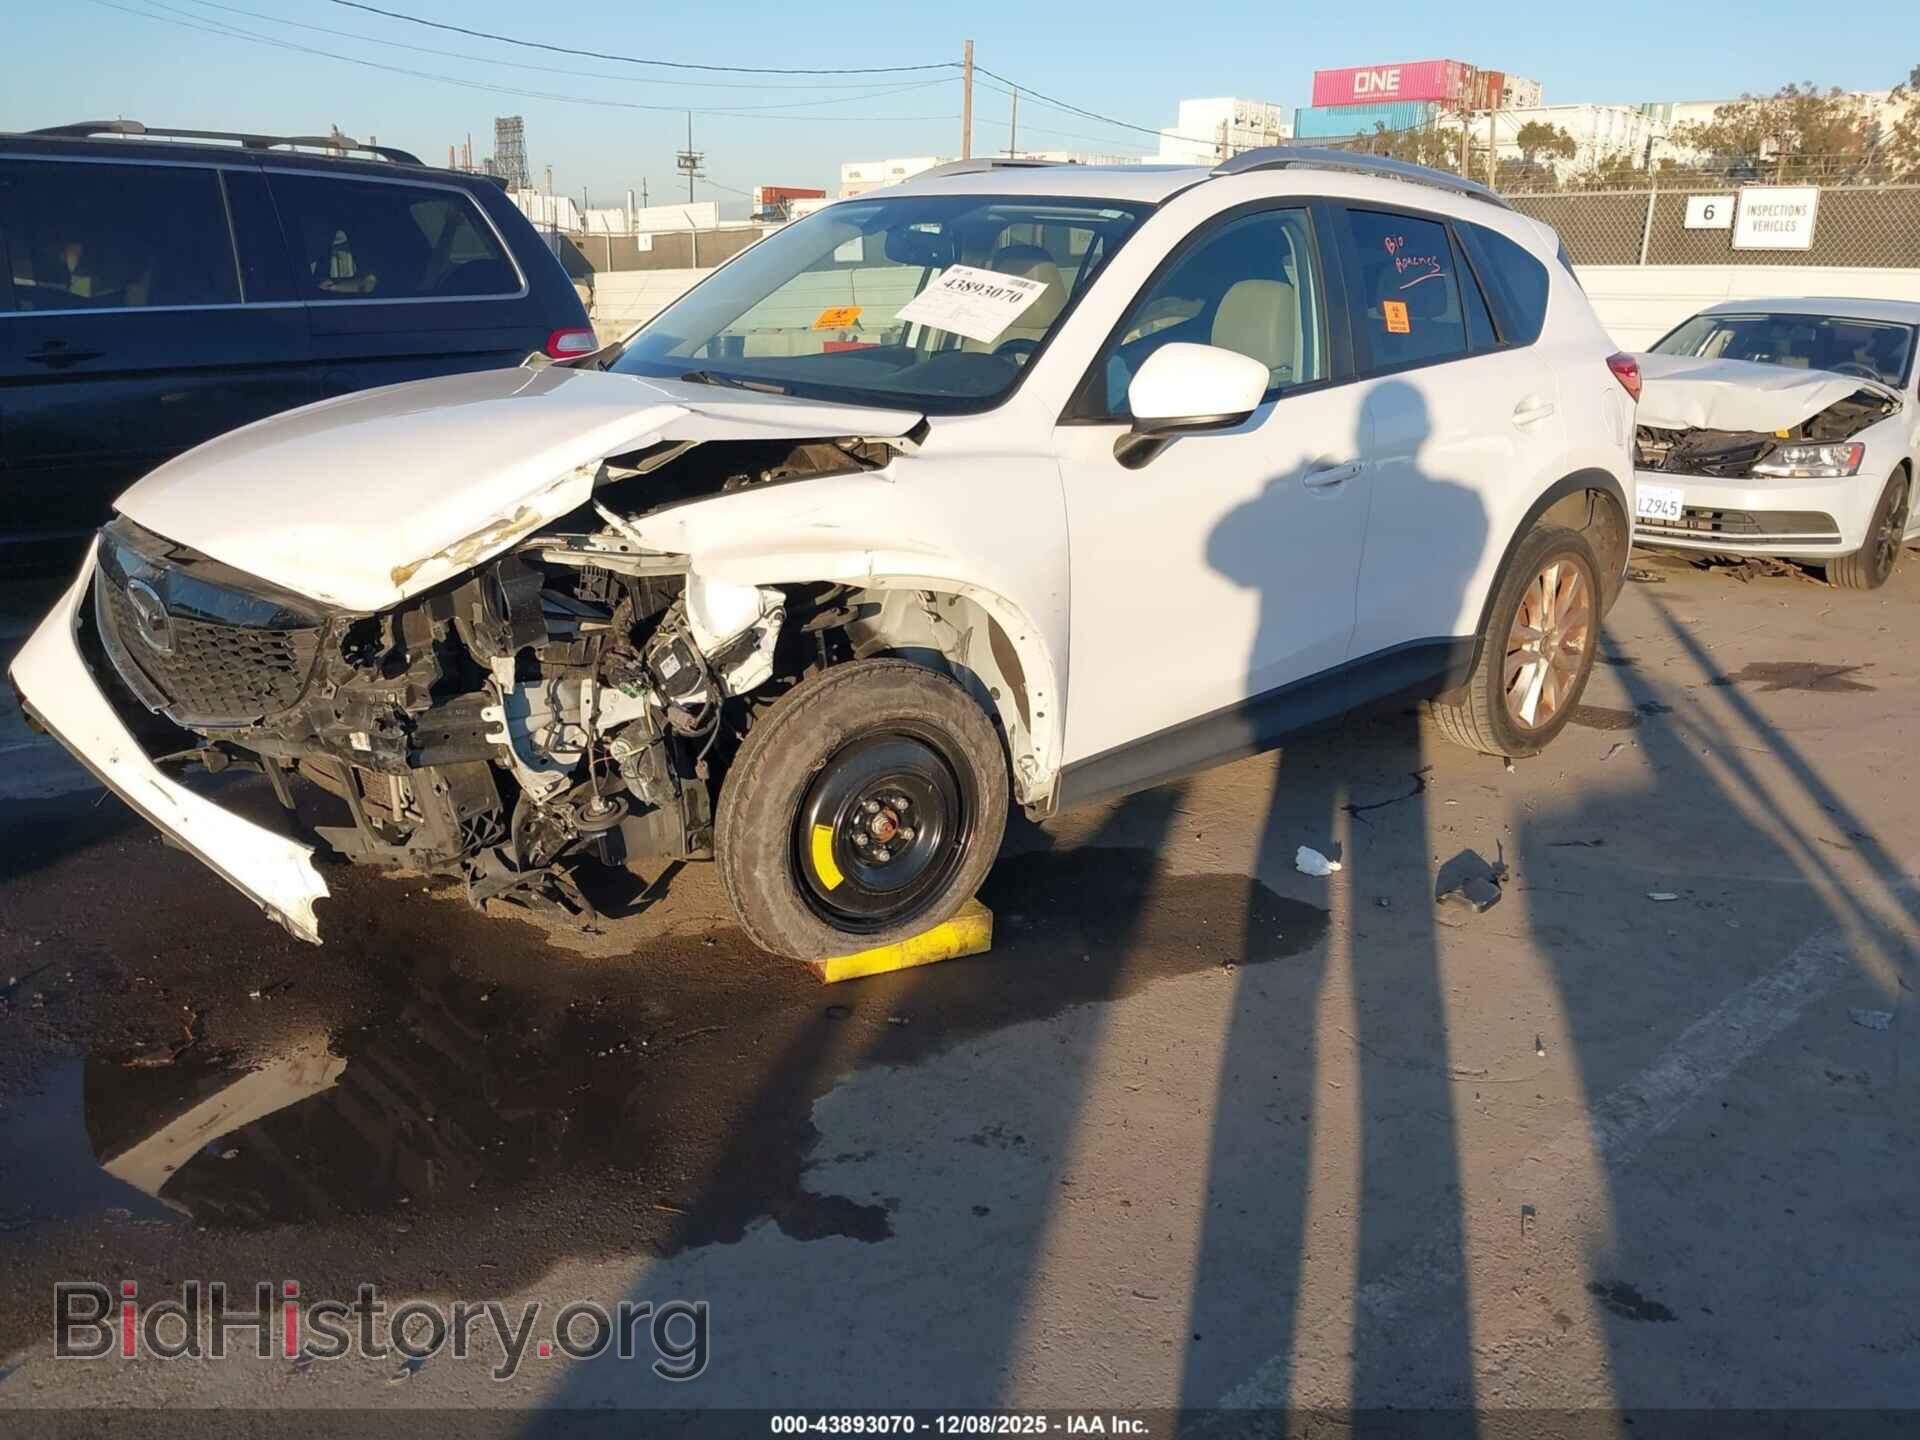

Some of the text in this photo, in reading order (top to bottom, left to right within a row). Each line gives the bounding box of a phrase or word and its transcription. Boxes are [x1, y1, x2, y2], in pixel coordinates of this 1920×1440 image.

[1354, 69, 1400, 93] ONE
[1703, 204, 1715, 221] 6
[1747, 204, 1808, 217] INSPECTIONS
[1752, 219, 1797, 233] VEHICLES
[943, 278, 1024, 303] 43893070
